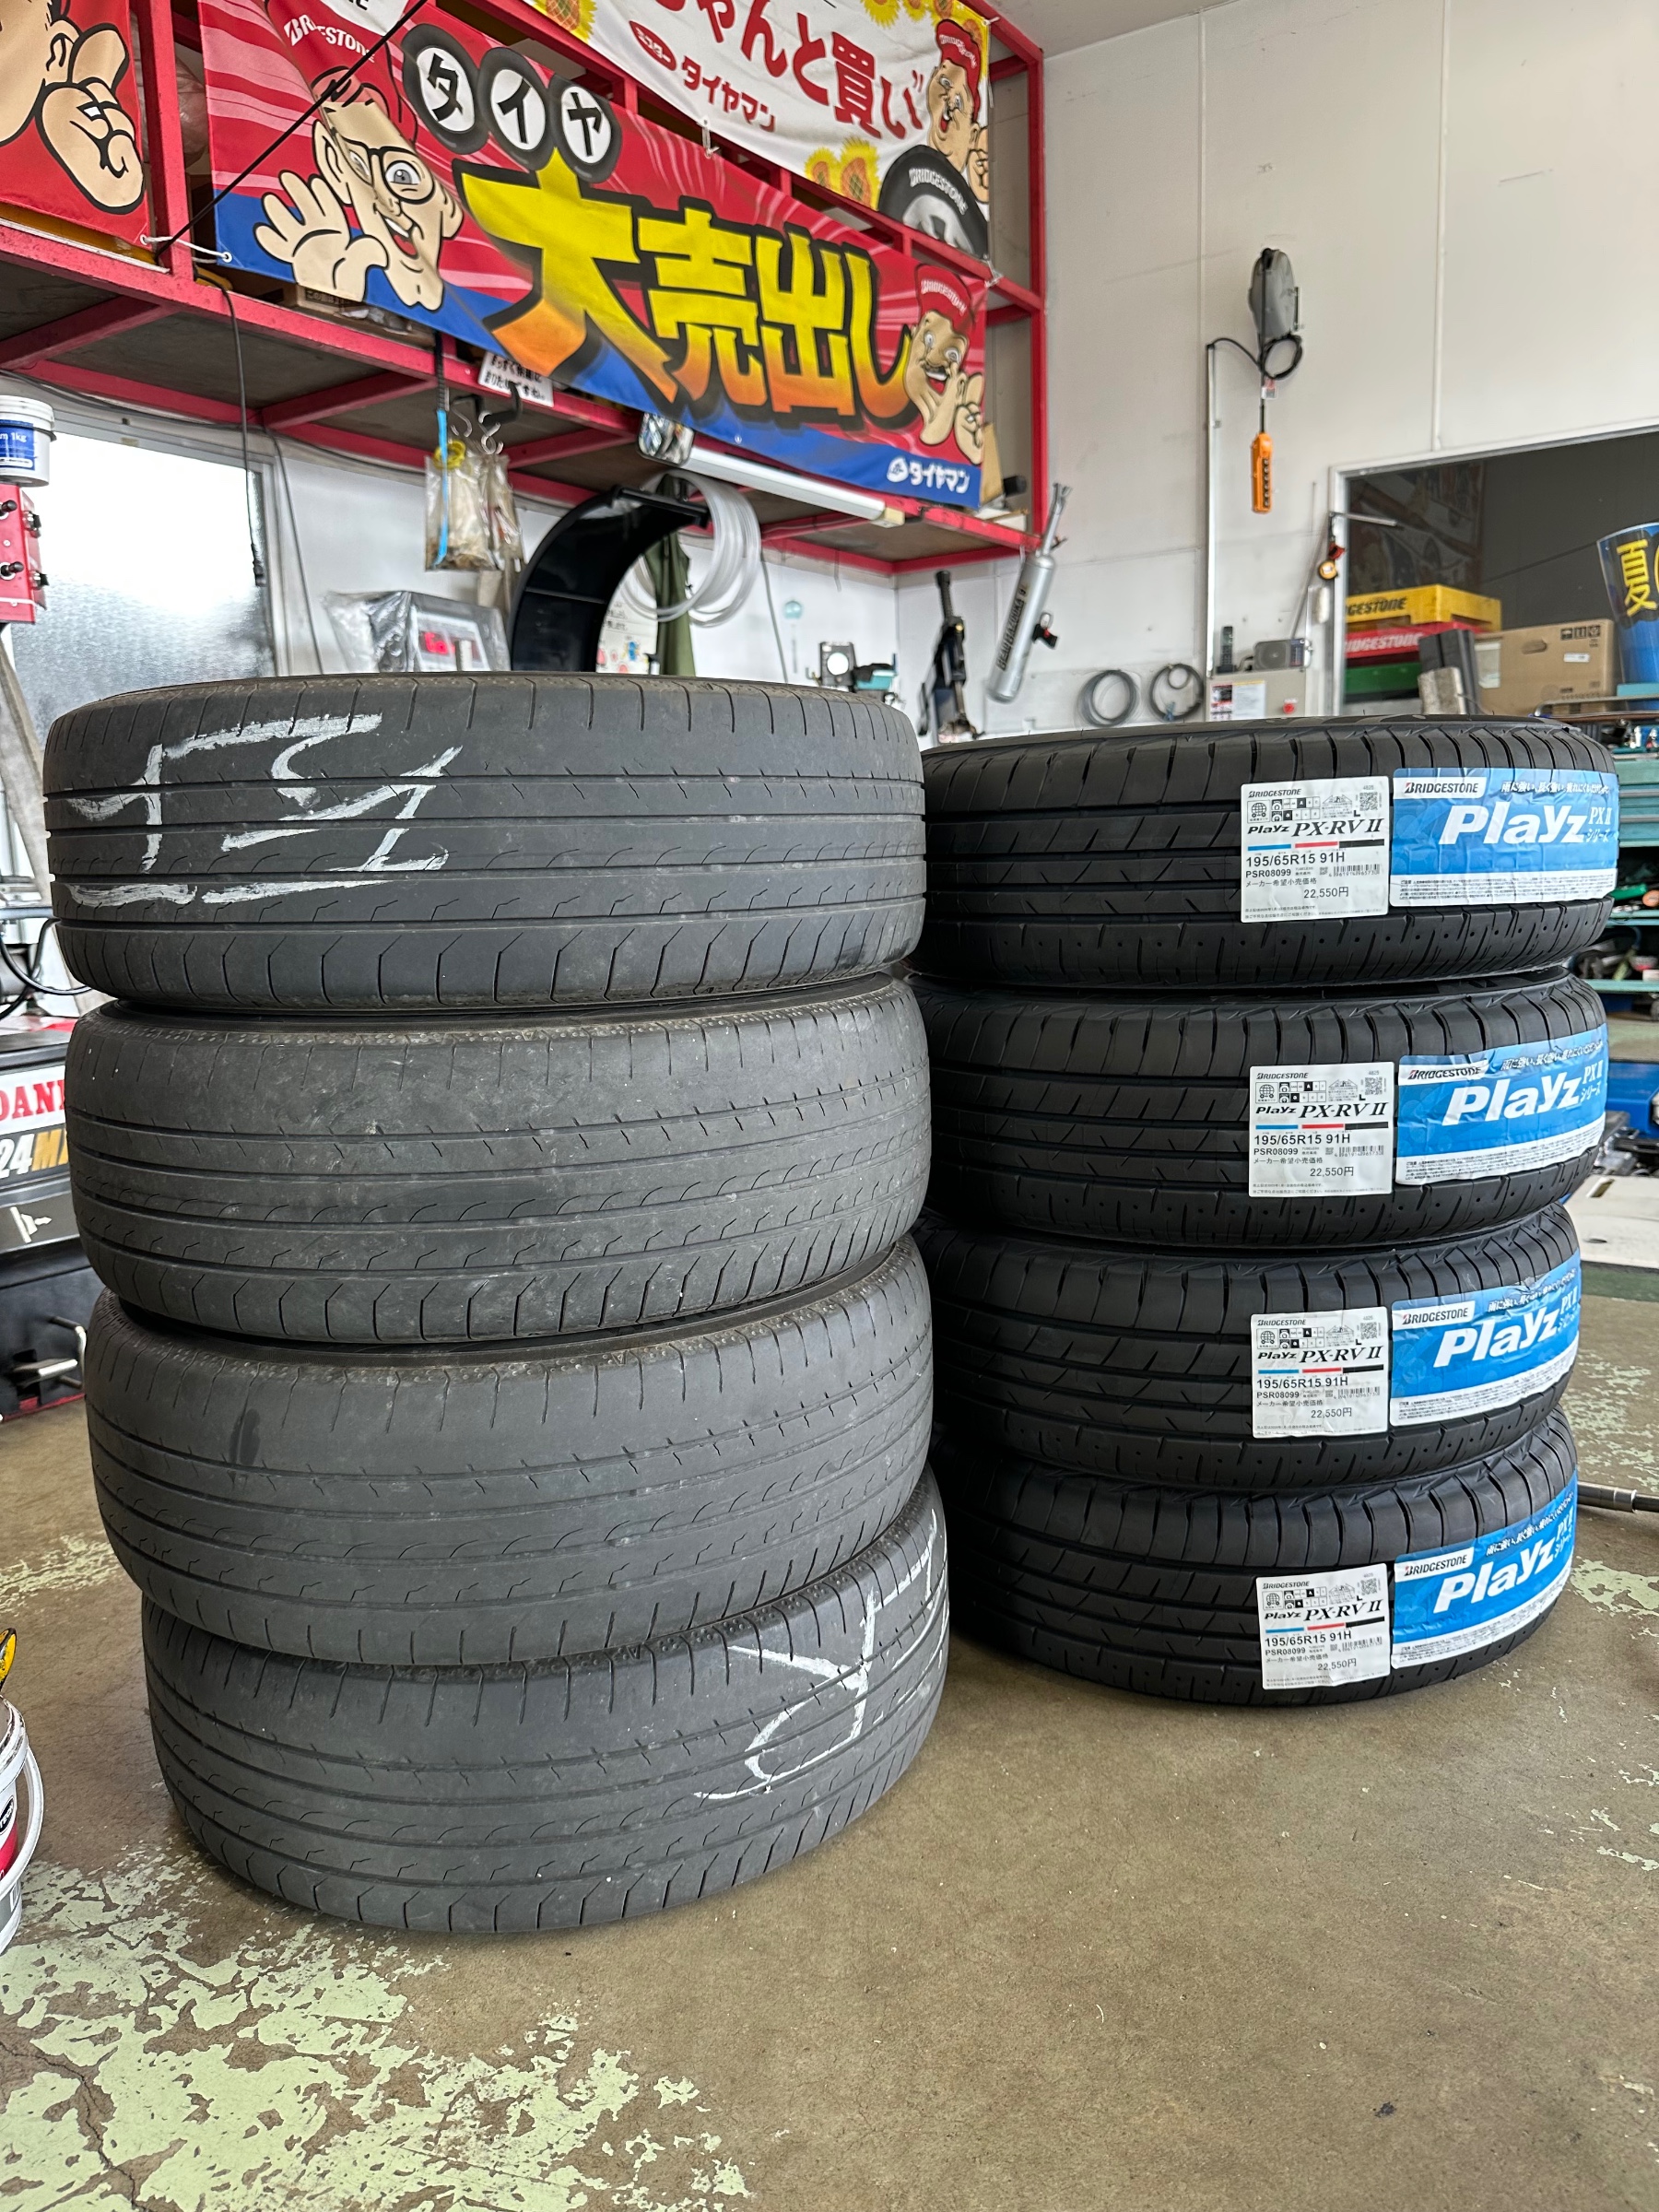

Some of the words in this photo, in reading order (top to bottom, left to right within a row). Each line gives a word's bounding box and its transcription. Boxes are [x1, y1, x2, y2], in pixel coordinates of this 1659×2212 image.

[681, 55, 776, 133] タイヤマン
[427, 53, 604, 159] タイヤ
[909, 168, 969, 216] BRIDGESTONE
[461, 146, 914, 419] 大売出し
[11, 431, 28, 443] 1kg
[909, 461, 971, 494] タイヤマン
[1616, 538, 1657, 617] 夏
[1346, 596, 1407, 617] GESTONE
[1248, 788, 1302, 798] BRIDGESTONE
[1404, 782, 1479, 794] BRIDGESTONE
[1247, 824, 1290, 834] Playz
[1439, 801, 1587, 845] Playz
[1585, 828, 1611, 843] シリーズ
[1246, 853, 1316, 867] 195/65R15
[1320, 852, 1346, 864] 91H
[1245, 868, 1291, 878] PSR08099
[1245, 878, 1317, 888] メーカー希望小売価格
[1303, 886, 1350, 900] 22,550円
[1256, 1072, 1309, 1080] BRIDGESTONE
[1407, 1067, 1482, 1080] BRIDGESTONE
[1580, 1081, 1602, 1103] シリーズ
[1441, 1072, 1582, 1126] Playz
[1255, 1106, 1297, 1114] Playz
[1254, 1135, 1322, 1146] 195/65R15
[1325, 1134, 1350, 1144] 91H
[1253, 1147, 1299, 1156] PSR08099
[1310, 1166, 1354, 1177] 22,550円
[1402, 1308, 1468, 1325] BRIDGESTONE
[1433, 1307, 1560, 1368] Playz
[1257, 1351, 1298, 1359] Playz
[1256, 1379, 1322, 1389] 195/65R15
[1324, 1376, 1348, 1386] 91H
[1311, 1407, 1352, 1418] 22,550円
[1404, 1554, 1467, 1576] BRIDGESTONE
[1433, 1539, 1556, 1614] Playz
[1263, 1581, 1310, 1589] BRIDGESTONE
[1264, 1611, 1301, 1620] Playz
[1265, 1634, 1326, 1647] 195/65R15
[1329, 1630, 1352, 1641] 91H
[1265, 1647, 1306, 1655] PSR08099
[1266, 1653, 1329, 1664] メーカー希望小売価格
[1317, 1658, 1357, 1671] 22,550円
